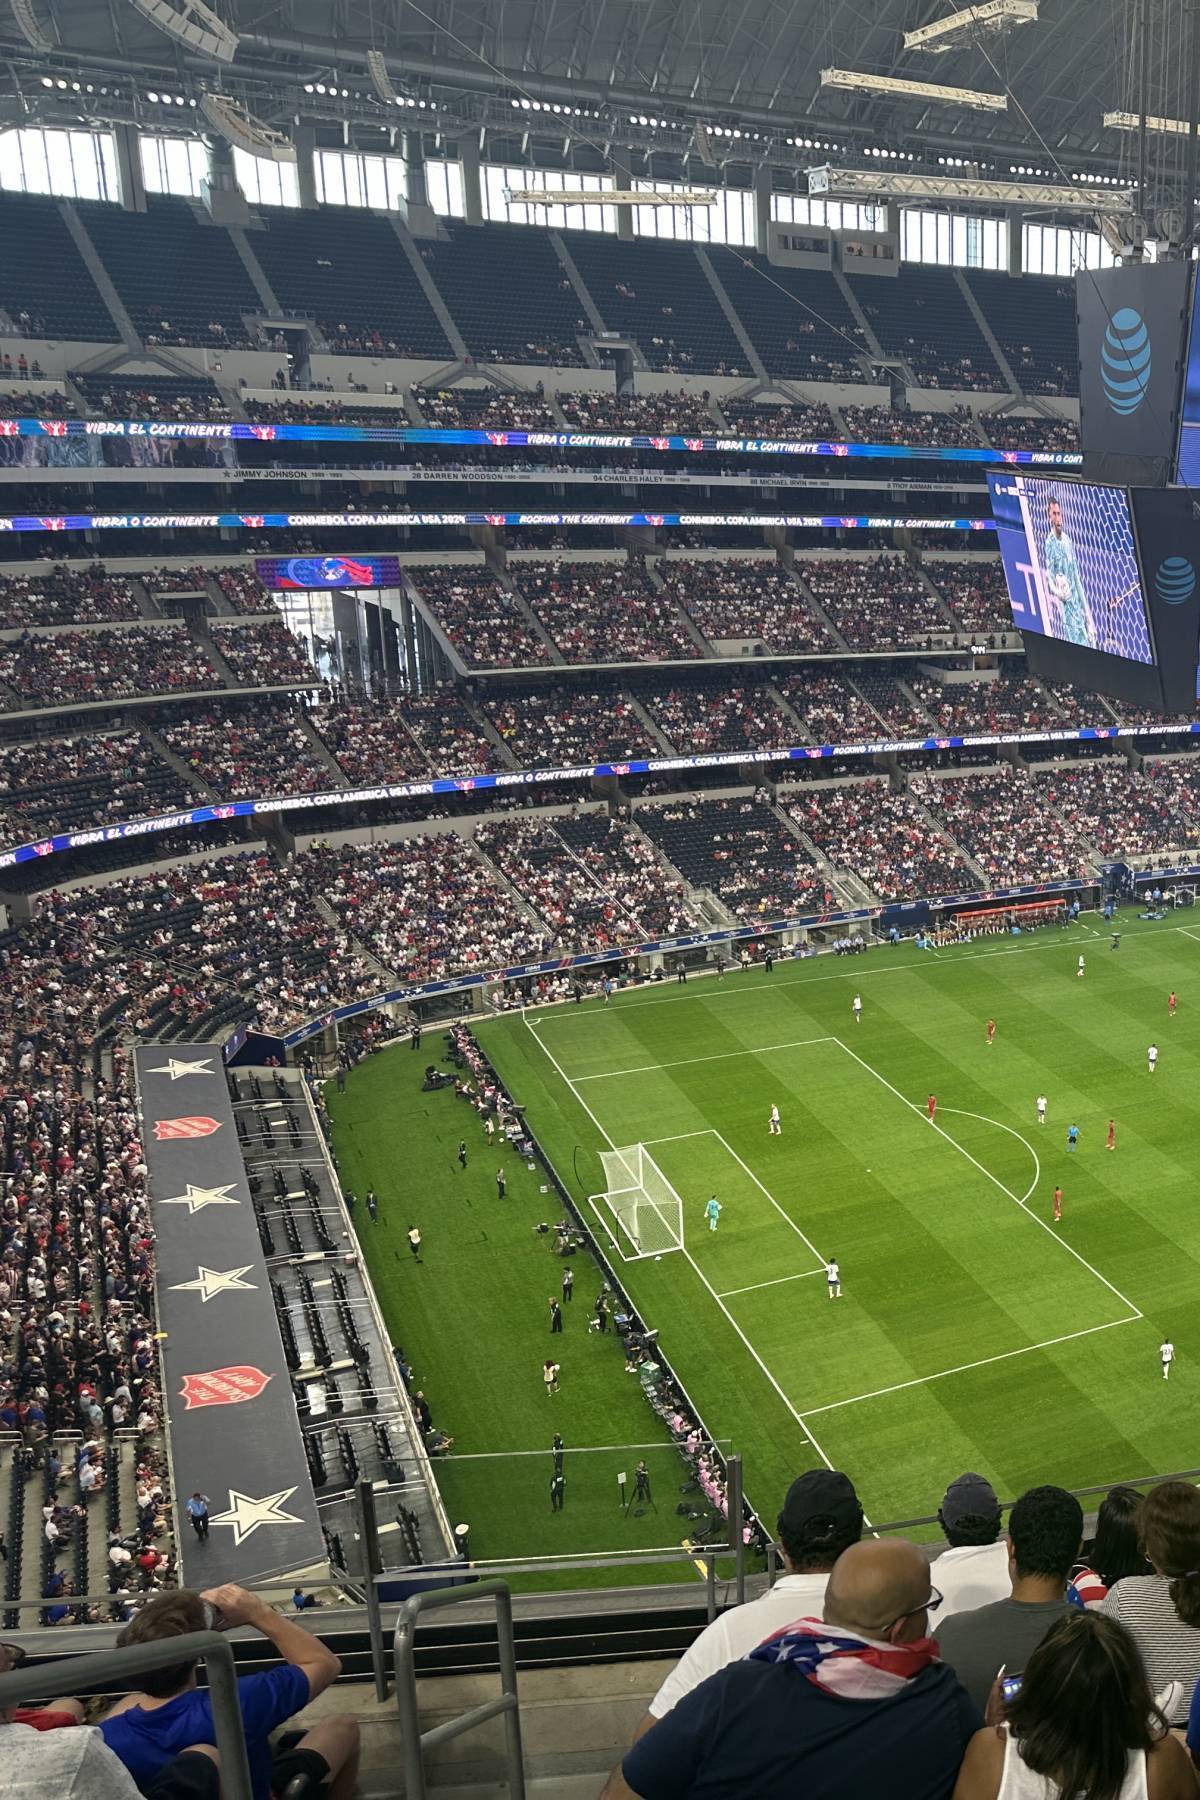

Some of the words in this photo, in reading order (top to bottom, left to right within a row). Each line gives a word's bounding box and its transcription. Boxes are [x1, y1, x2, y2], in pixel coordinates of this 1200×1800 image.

[86, 422, 124, 434] VIBRA
[129, 423, 146, 435] EL
[151, 423, 232, 437] CONTINENTE
[527, 434, 557, 445] VIBRA
[559, 435, 566, 445] O
[569, 436, 632, 447] CONTINENTE
[716, 441, 743, 451] VIBRA
[746, 442, 757, 451] EL
[760, 442, 819, 454] CONTINENTE
[1032, 453, 1054, 462] VIBRA
[234, 470, 262, 478] JIMMY
[264, 471, 307, 479] JOHNSON
[461, 473, 503, 481] WOODSON
[92, 516, 127, 527] VIBRA
[131, 517, 138, 526] O
[143, 517, 219, 527] CONTINENTE
[288, 515, 347, 525] CONMEBOL
[422, 515, 442, 524] USA
[442, 515, 466, 524] 2024
[520, 515, 560, 525] ROCKING
[562, 515, 580, 524] THE
[581, 515, 633, 524] CONTINENT
[680, 516, 726, 525] CONMEBOL
[787, 517, 802, 526] USA
[803, 517, 822, 526] 2024
[868, 519, 892, 527] VIBRA
[894, 519, 904, 527] EL
[906, 519, 956, 528] CONTINENTE
[963, 736, 1001, 746] CONMEBOL
[833, 746, 866, 756] ROCKING
[868, 745, 883, 753] THE
[884, 742, 926, 752] CONTINENT
[648, 757, 695, 771] CONMEBOL
[755, 752, 771, 762] USA
[771, 751, 790, 761] 2024
[496, 771, 523, 786] VIBRA
[526, 772, 532, 781] O
[535, 767, 596, 782] CONTINENTE
[254, 795, 314, 812] CONMEBOL
[389, 785, 409, 797] USA
[409, 783, 433, 795] 2024
[69, 832, 104, 847] VIBRA
[107, 829, 122, 838] EL
[124, 813, 192, 835] CONTINENTE
